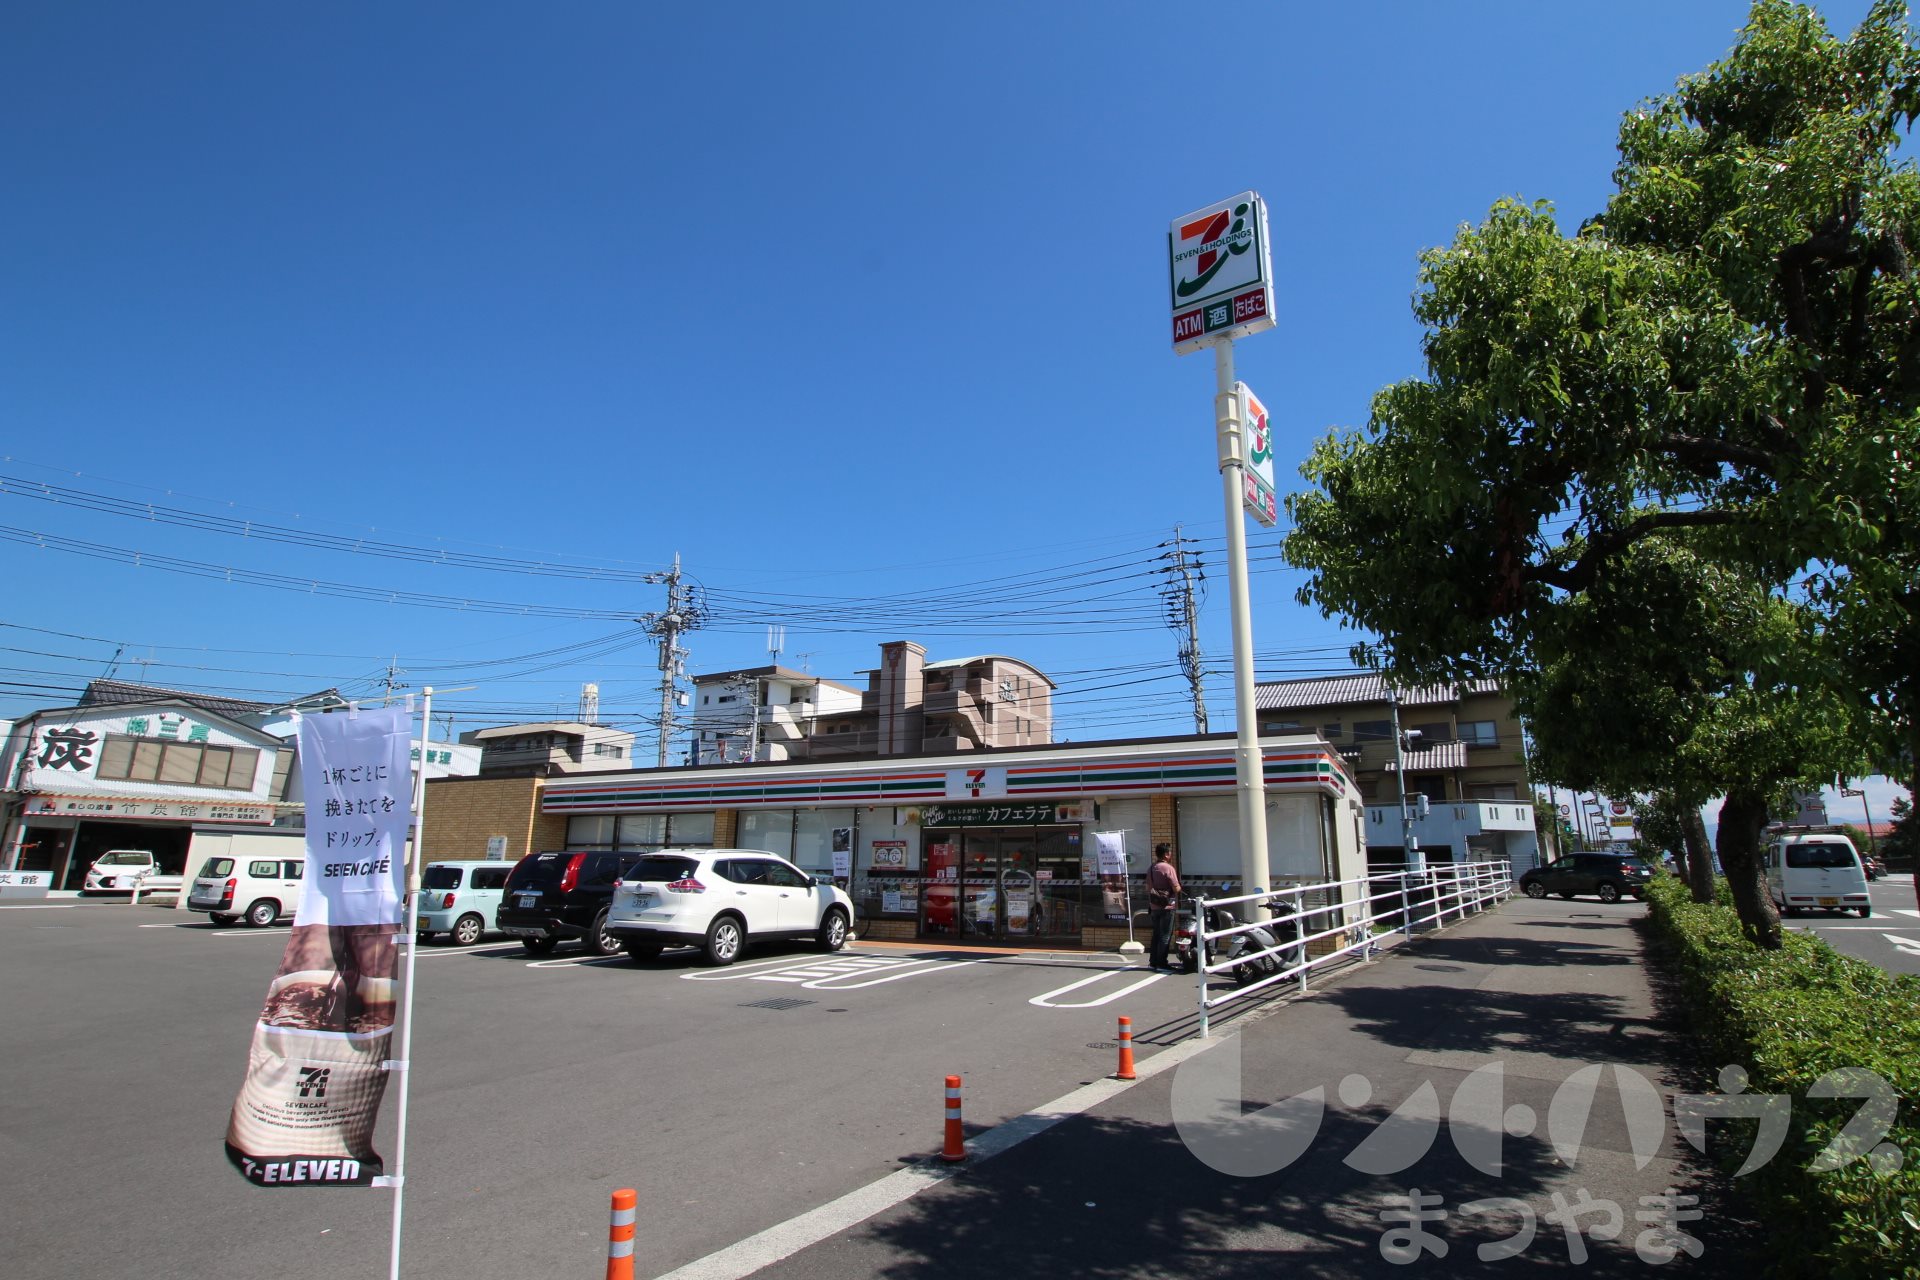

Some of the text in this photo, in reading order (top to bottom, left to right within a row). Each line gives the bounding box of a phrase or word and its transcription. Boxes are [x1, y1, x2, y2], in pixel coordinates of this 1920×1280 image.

[1209, 228, 1252, 250] HOLDINGS
[1208, 305, 1228, 328] 酒
[1235, 294, 1265, 319] たばこ
[1175, 313, 1201, 338] ATM
[37, 727, 99, 772] 炭
[322, 765, 388, 786] 1杯ごとに
[121, 802, 199, 817] 竹炭館
[325, 795, 396, 817] 挽きたてを
[986, 805, 1052, 822] カフェラテ
[360, 855, 391, 876] CAFÉ
[285, 1101, 310, 1109] SEVEN
[286, 1108, 317, 1116] beverages
